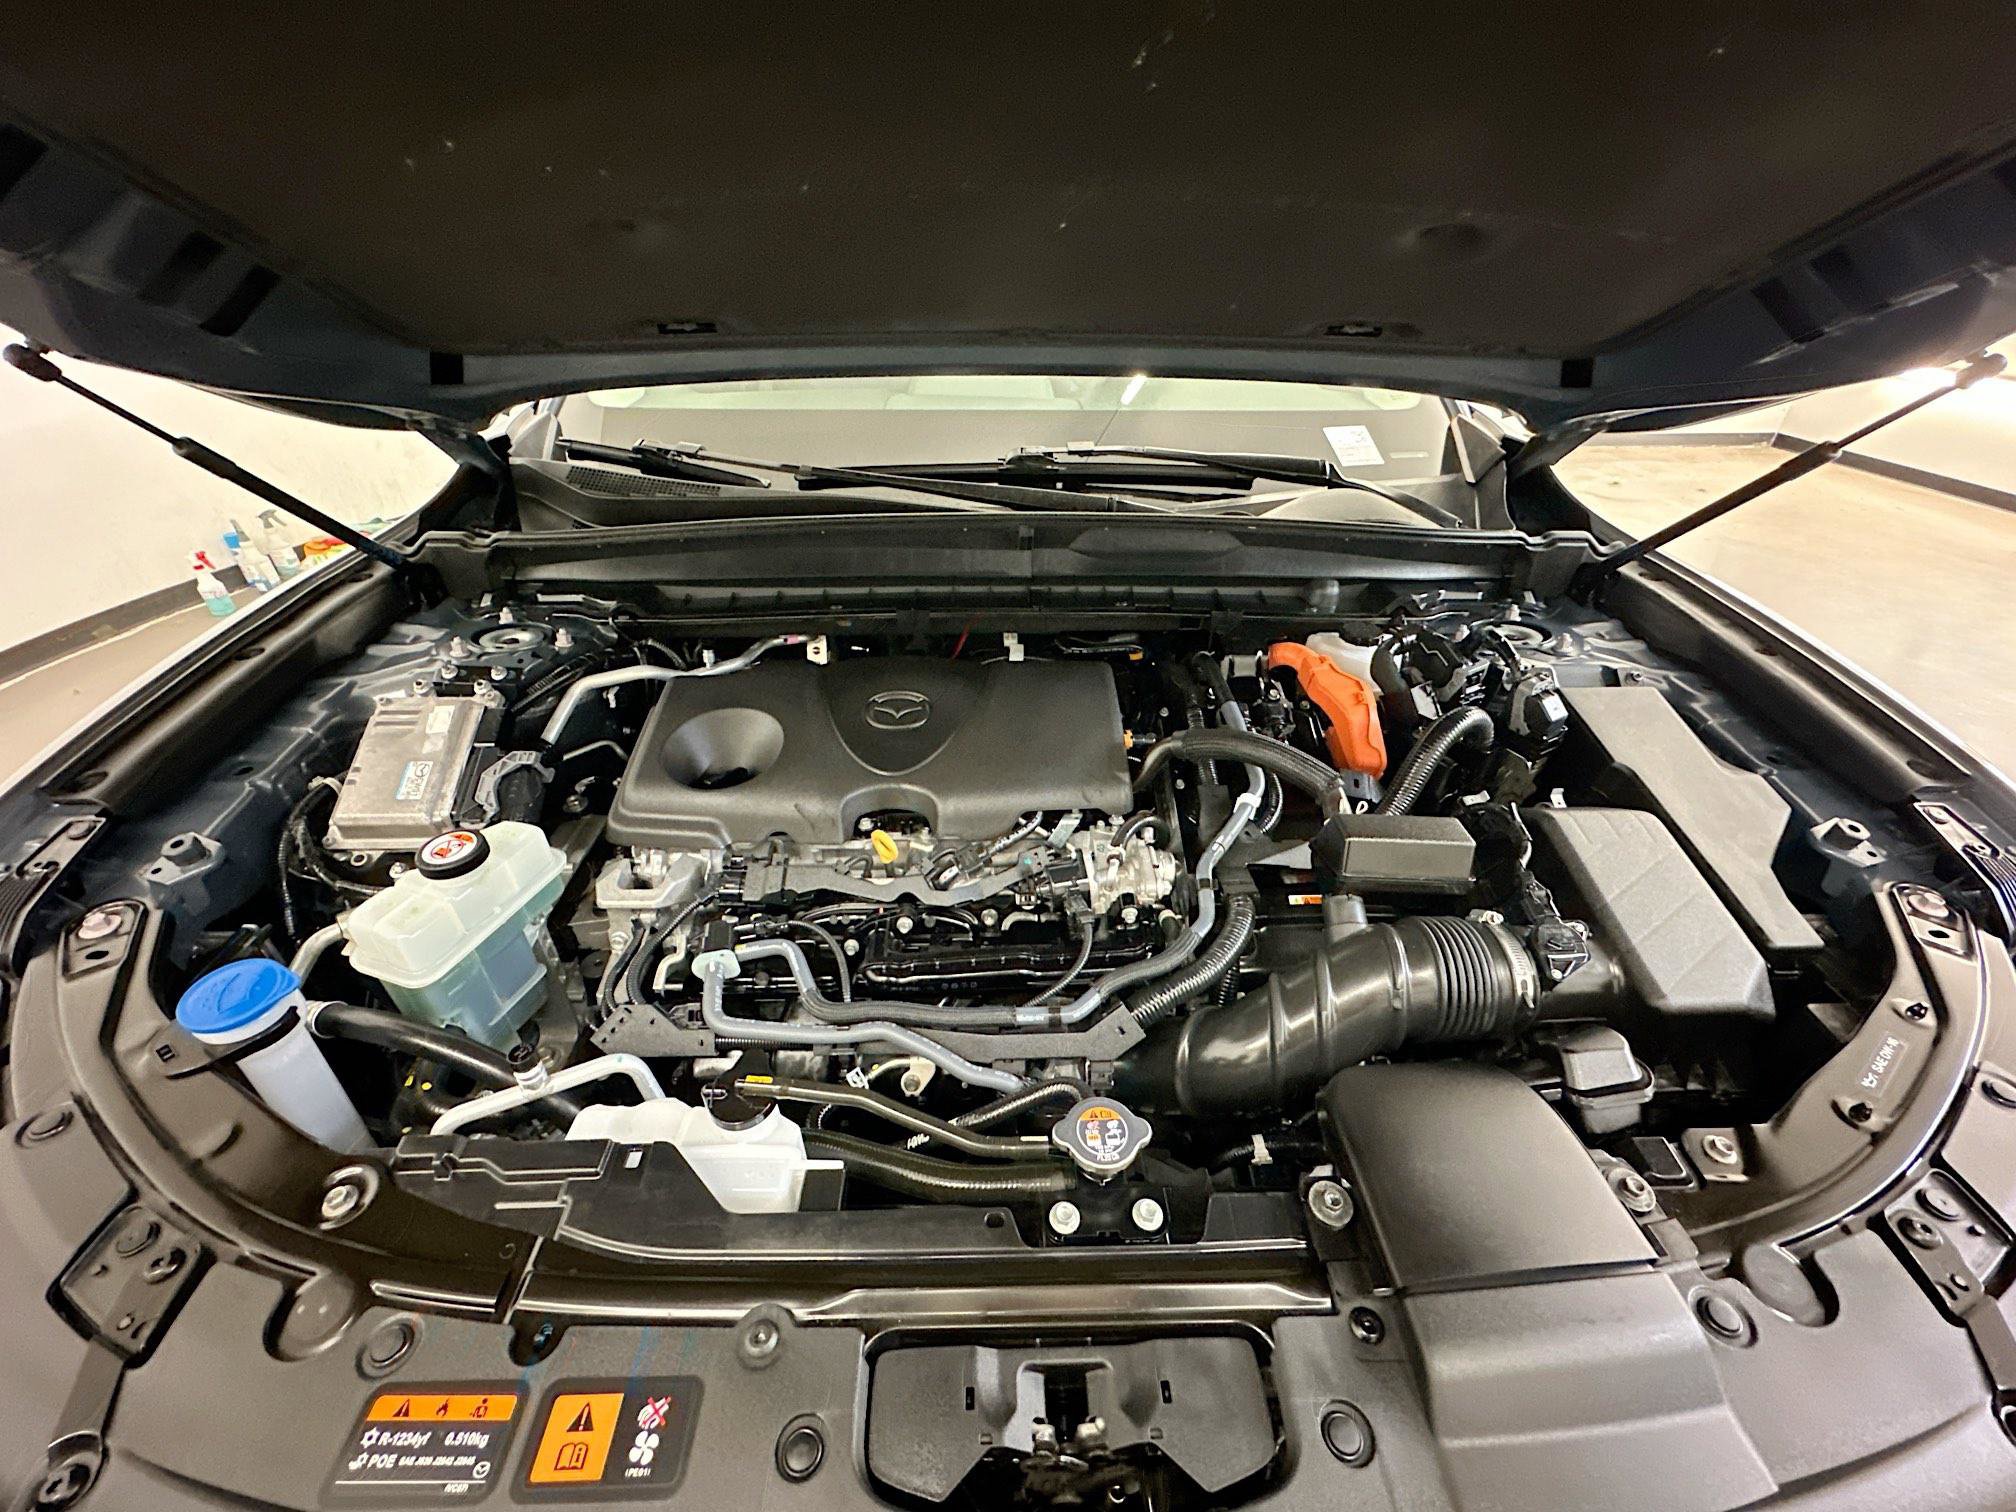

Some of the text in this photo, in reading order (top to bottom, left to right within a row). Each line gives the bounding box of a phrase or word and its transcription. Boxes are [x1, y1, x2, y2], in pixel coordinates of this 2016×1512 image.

[1871, 1056, 1889, 1073] SAE
[378, 1431, 489, 1449] R-1234yf 0.510kg
[367, 1454, 398, 1469] POE
